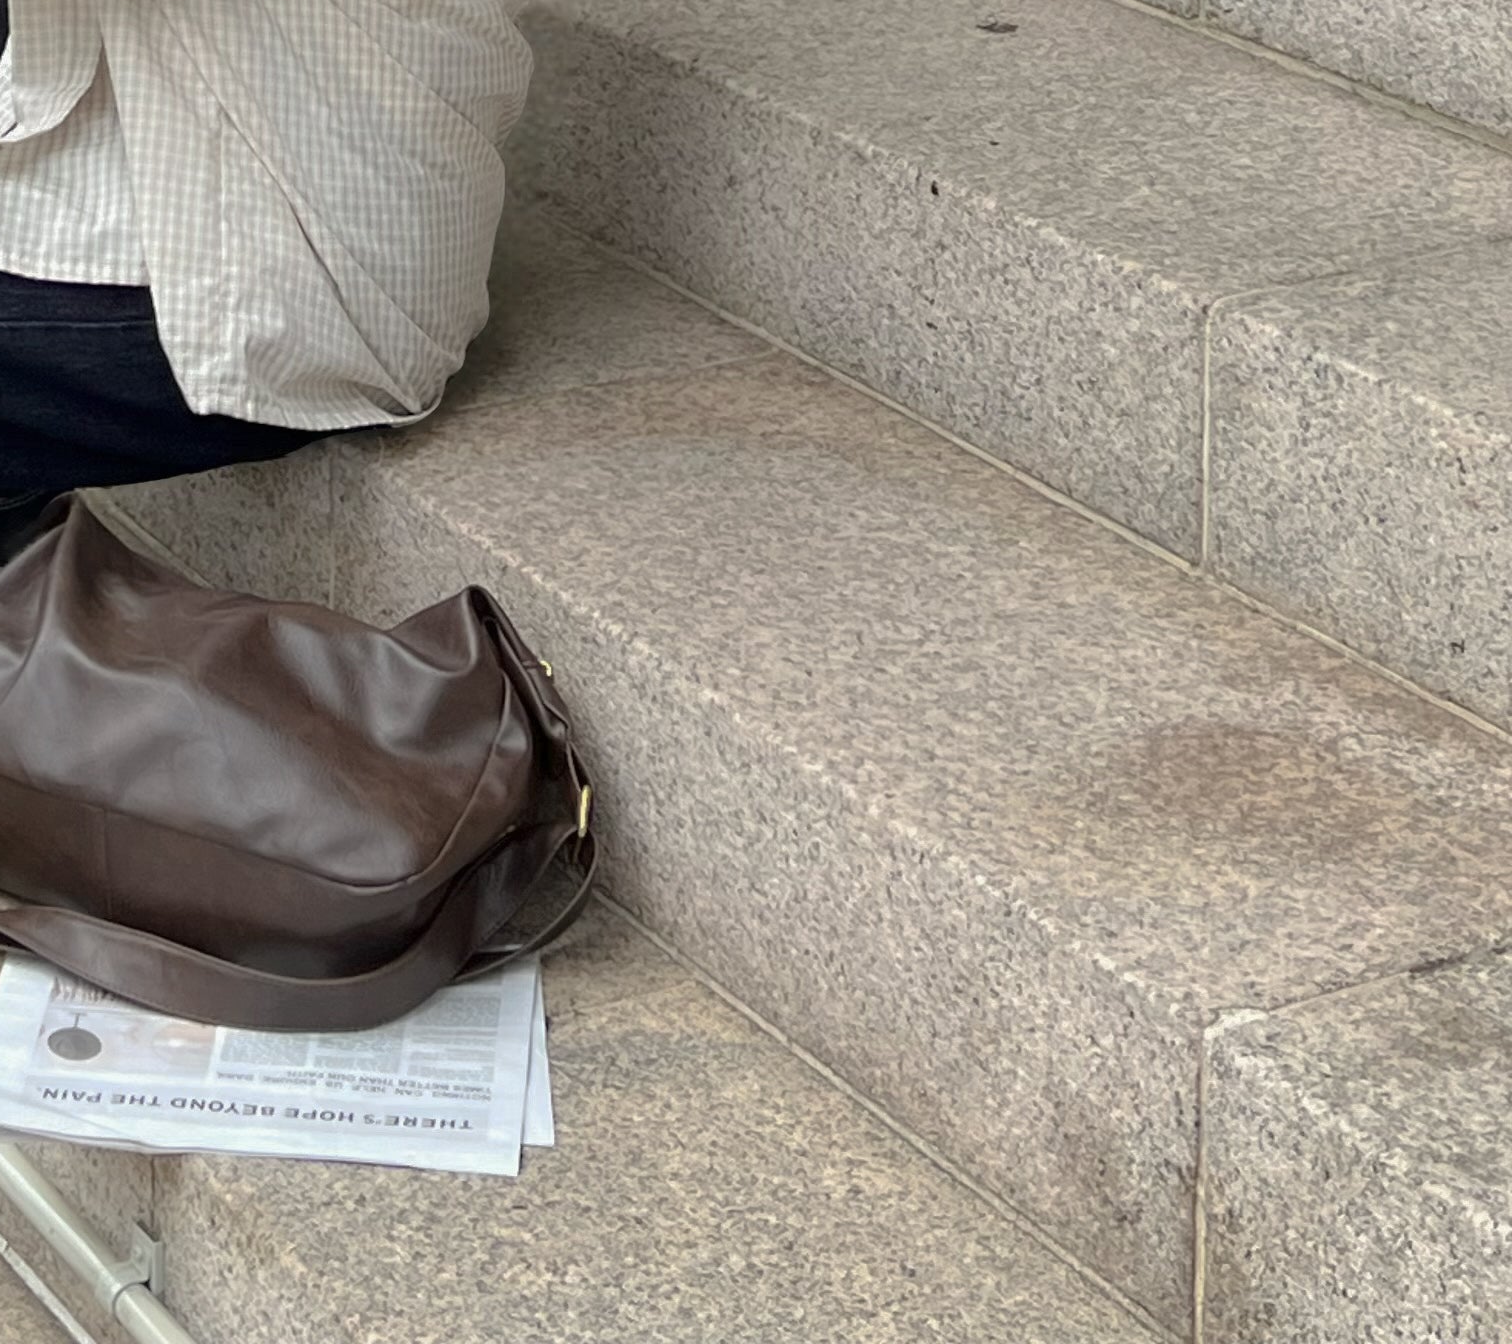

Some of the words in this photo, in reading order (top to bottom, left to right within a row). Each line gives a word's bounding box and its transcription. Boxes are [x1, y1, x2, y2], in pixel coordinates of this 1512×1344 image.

[359, 1076, 393, 1086] THAN
[36, 1086, 102, 1104] PAIN.
[110, 1093, 162, 1108] THE
[394, 1088, 423, 1097] CAN
[170, 1098, 276, 1117] BEYOND
[284, 1107, 355, 1123] HOPE
[363, 1114, 473, 1130] THERE'S
